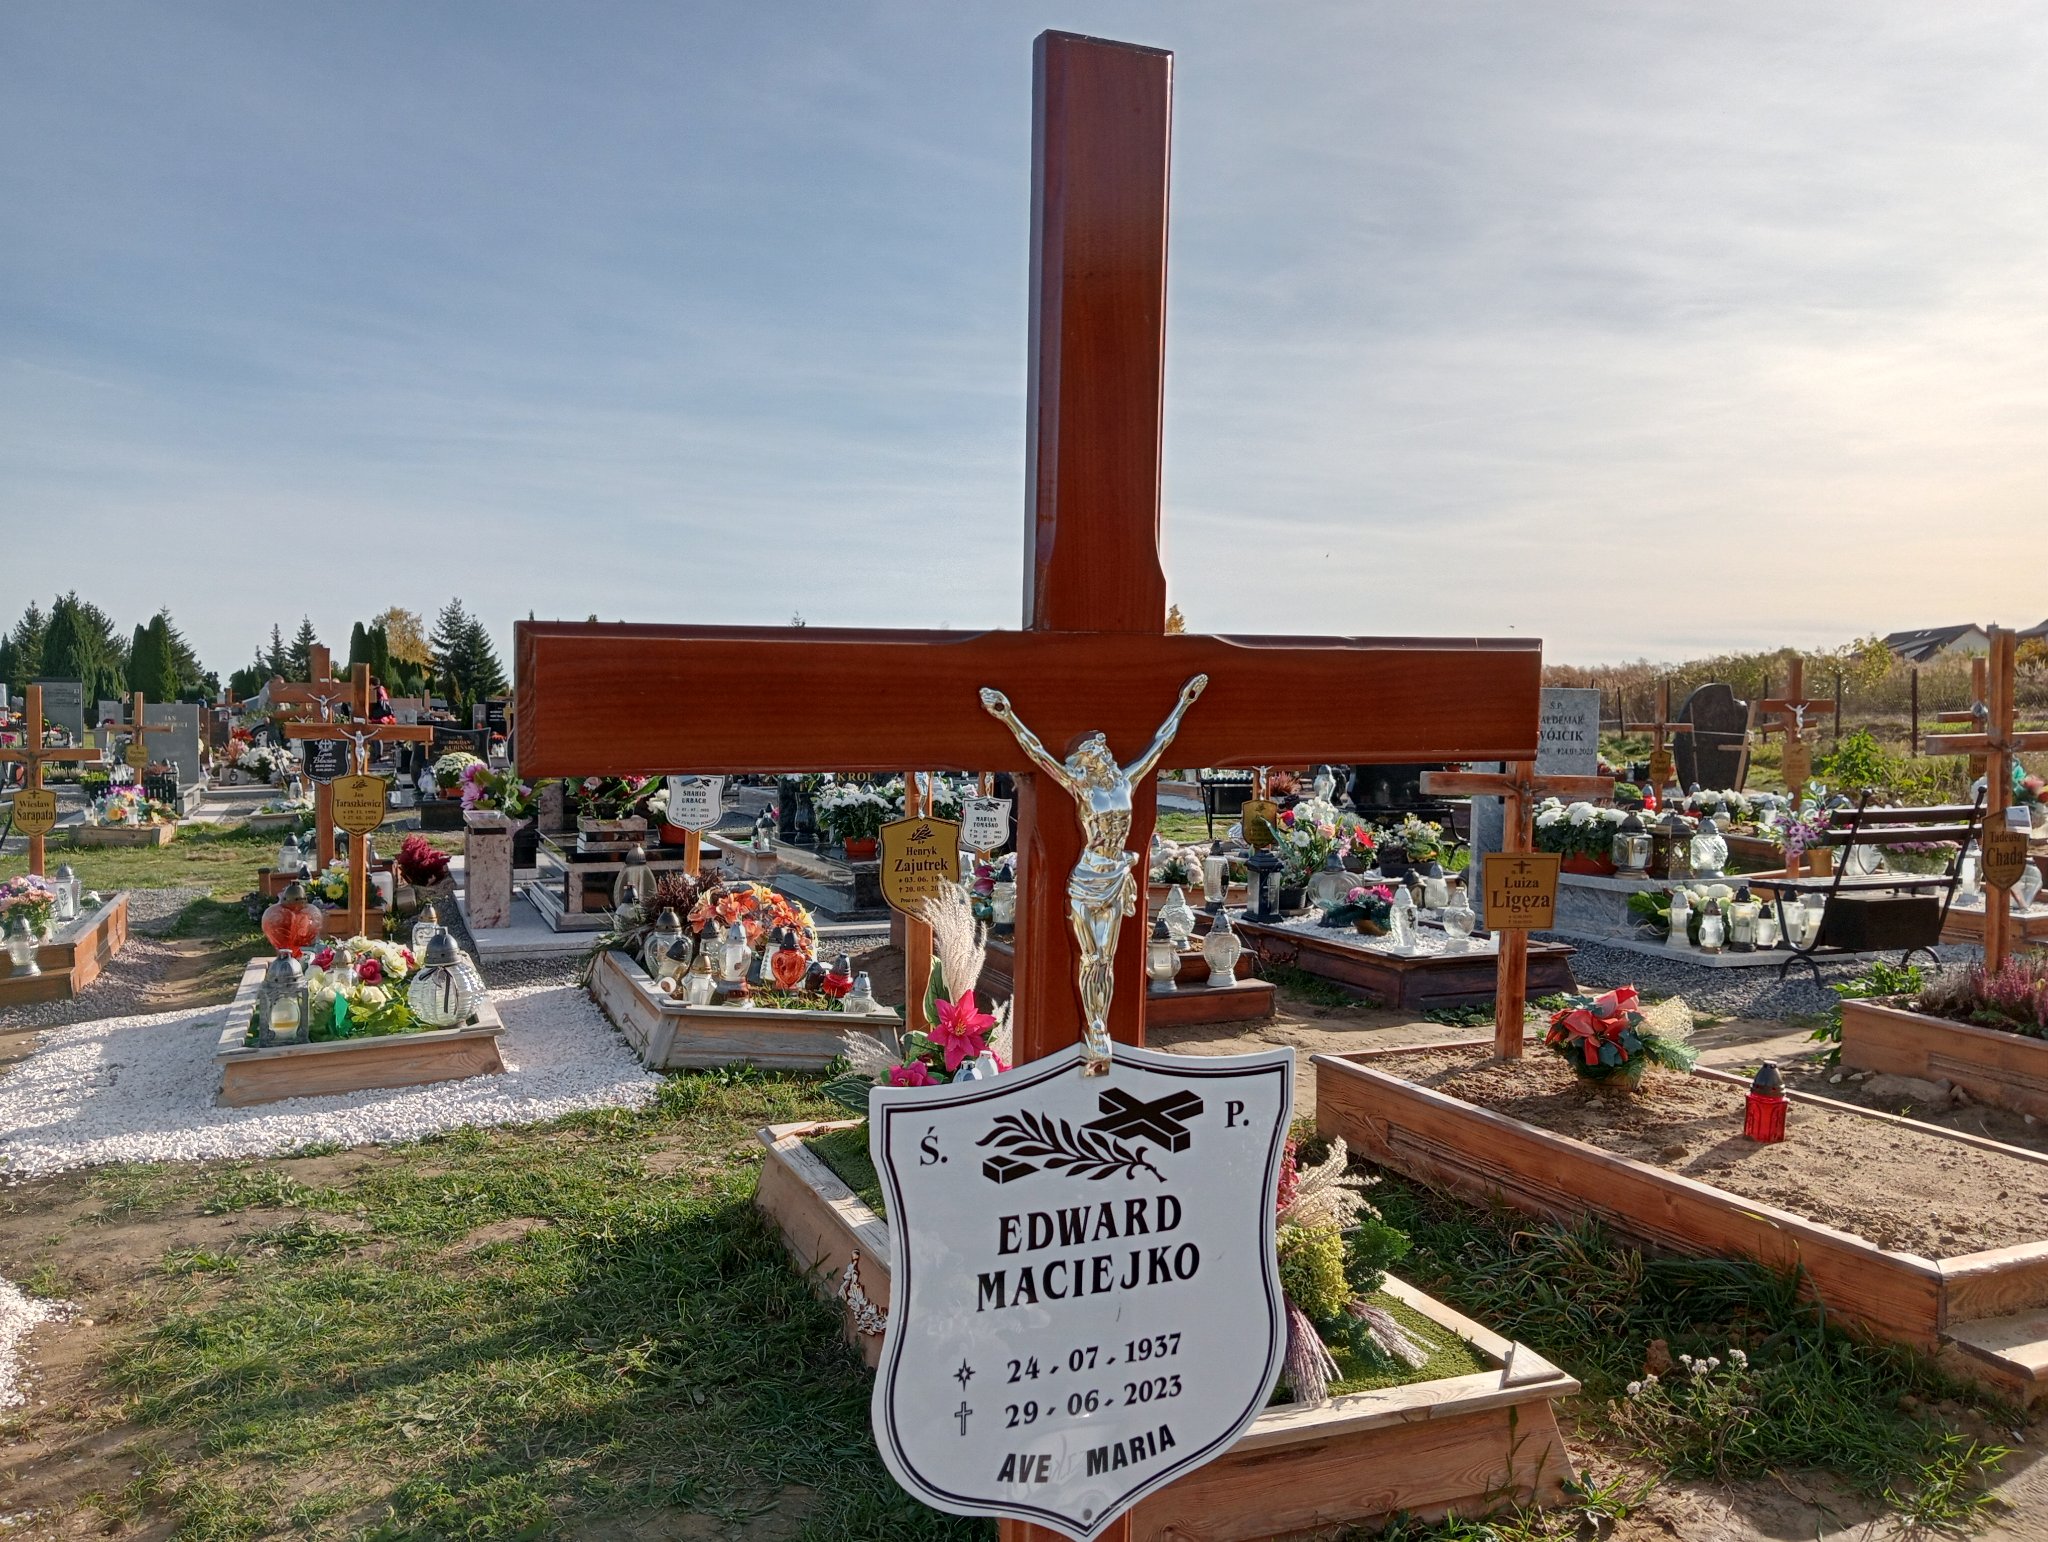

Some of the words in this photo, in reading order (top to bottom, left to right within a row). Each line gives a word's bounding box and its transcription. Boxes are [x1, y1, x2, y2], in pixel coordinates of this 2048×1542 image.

[1541, 714, 1585, 724] ALDEMAR
[336, 799, 382, 807] Taraszkiewicz
[17, 809, 54, 823] Sarapata
[1990, 831, 2021, 843] Tadeusz
[906, 846, 937, 857] Henryk
[1986, 847, 2023, 867] Chada
[894, 858, 949, 875] Zajutrek
[1504, 876, 1539, 888] Luiza
[1492, 890, 1550, 913] Ligęza
[919, 1126, 949, 1166] Ś.
[1224, 1100, 1250, 1128] P.
[997, 1194, 1182, 1256] EDWARD
[976, 1242, 1200, 1313] MACIEJKO
[1124, 1331, 1181, 1363] 1937
[1123, 1374, 1183, 1406] 2023
[996, 1453, 1052, 1483] AVE
[1086, 1424, 1177, 1477] MARIA
